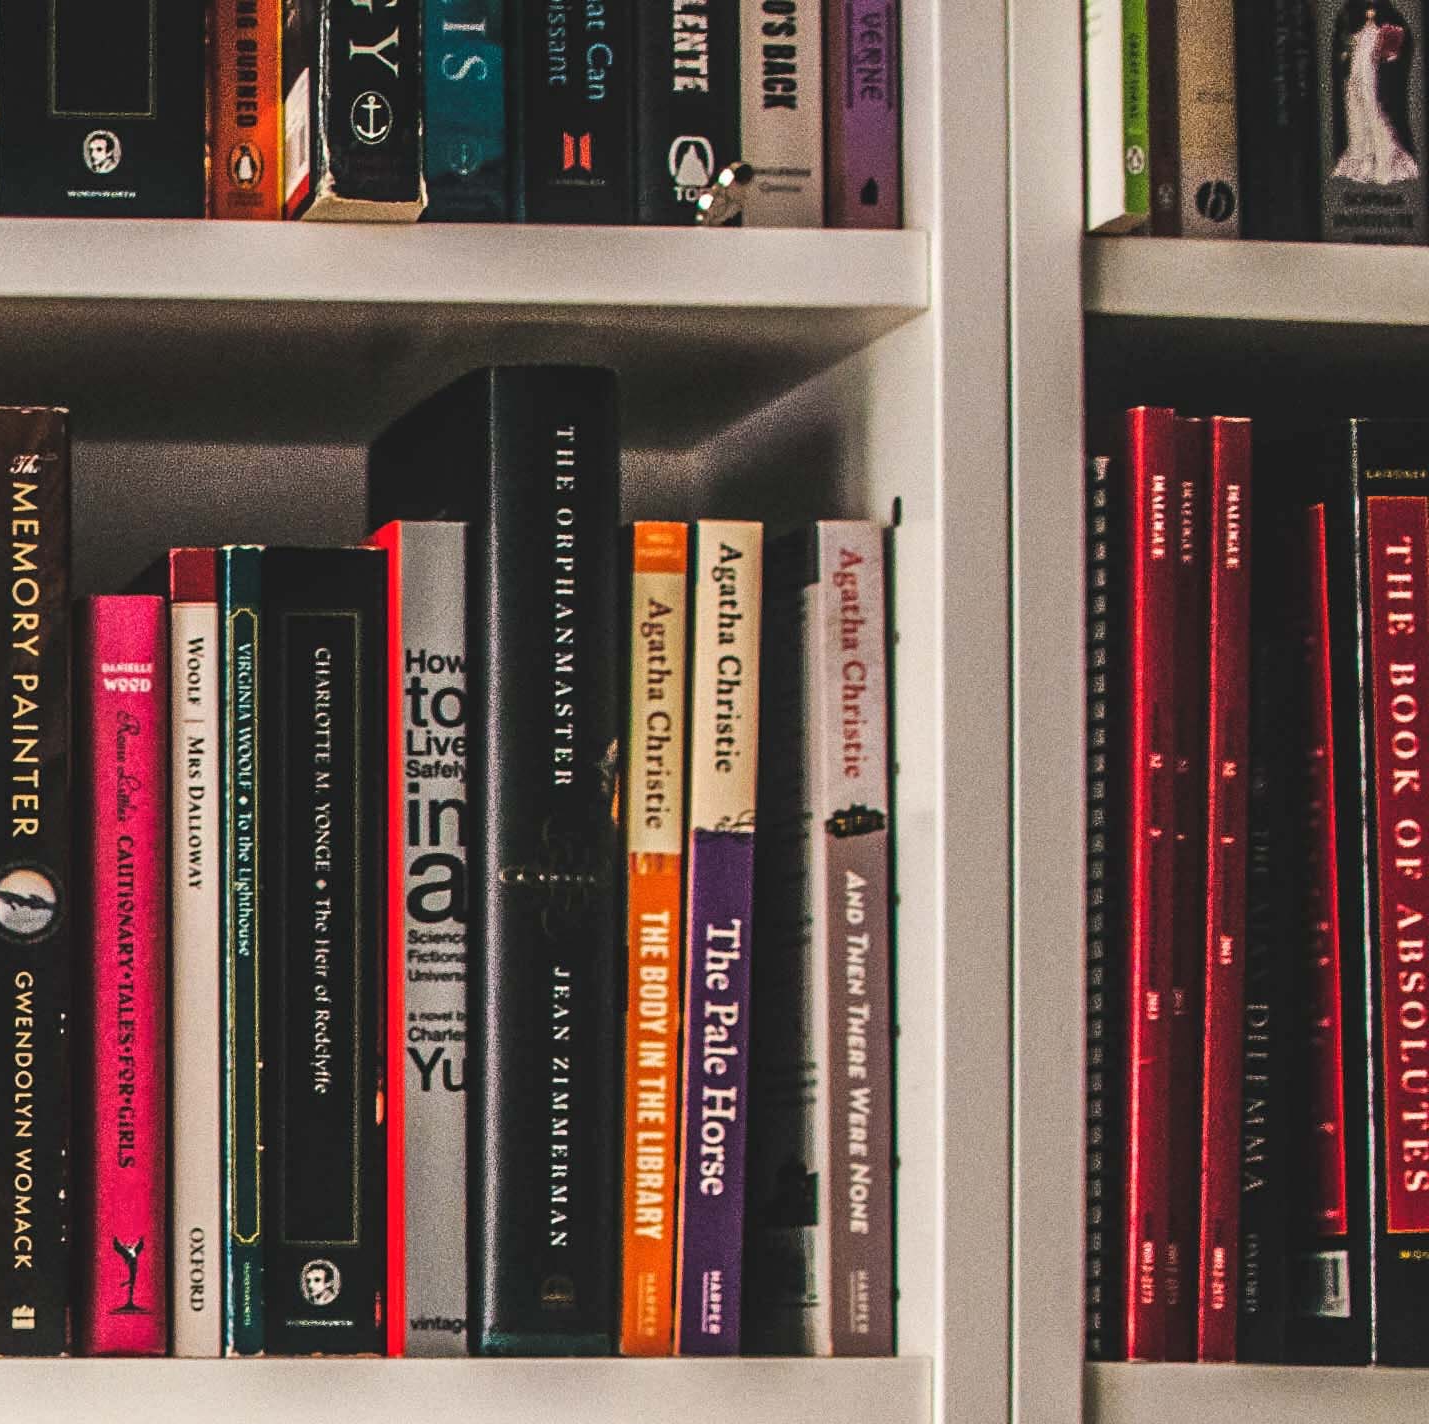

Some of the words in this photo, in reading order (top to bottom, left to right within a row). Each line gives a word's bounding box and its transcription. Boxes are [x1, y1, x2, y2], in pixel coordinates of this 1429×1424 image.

[763, 45, 796, 110] BACK
[10, 480, 41, 658] MEMORY
[711, 542, 744, 646] Agatha
[1386, 535, 1415, 636] THE
[10, 673, 41, 838] PAINTER
[714, 654, 741, 774] Christie
[1388, 662, 1421, 794] BOOK
[639, 911, 670, 958] THE
[704, 917, 741, 992] The
[552, 967, 570, 1042] JEAN
[639, 967, 668, 1034] BODY
[702, 1000, 738, 1077] Pale
[13, 971, 33, 1138] GWENDOLYN
[637, 1076, 666, 1124] THE
[639, 1041, 666, 1068] IN
[550, 1056, 570, 1247] ZIMMERMAN
[634, 1132, 666, 1241] LIBRARY
[699, 1086, 736, 1197] Horse
[12, 1149, 33, 1270] WOMACK
[189, 1226, 205, 1312] OXFORD
